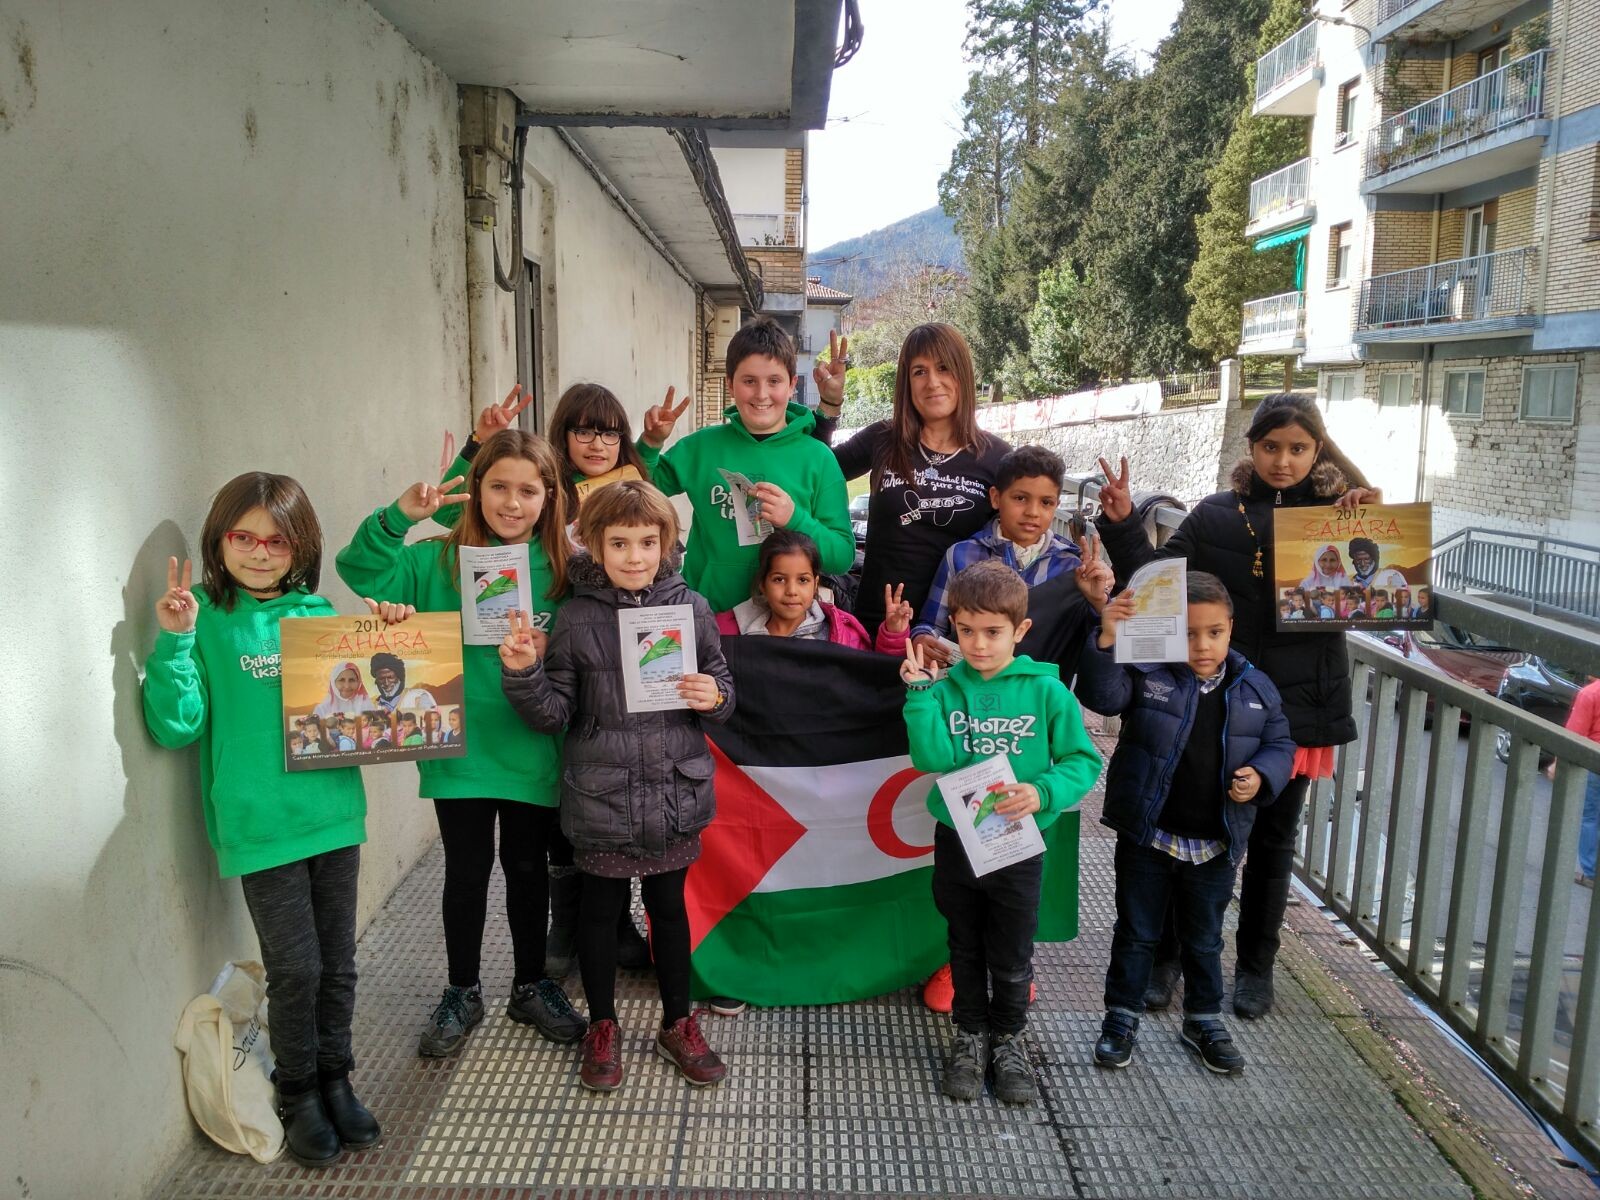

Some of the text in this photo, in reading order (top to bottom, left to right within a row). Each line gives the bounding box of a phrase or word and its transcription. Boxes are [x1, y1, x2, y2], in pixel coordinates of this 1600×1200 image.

[930, 481, 954, 492] gure
[1336, 508, 1367, 521] 2017
[1303, 518, 1401, 538] SAHARA
[354, 619, 388, 633] 2017
[315, 629, 429, 654] SAHARA
